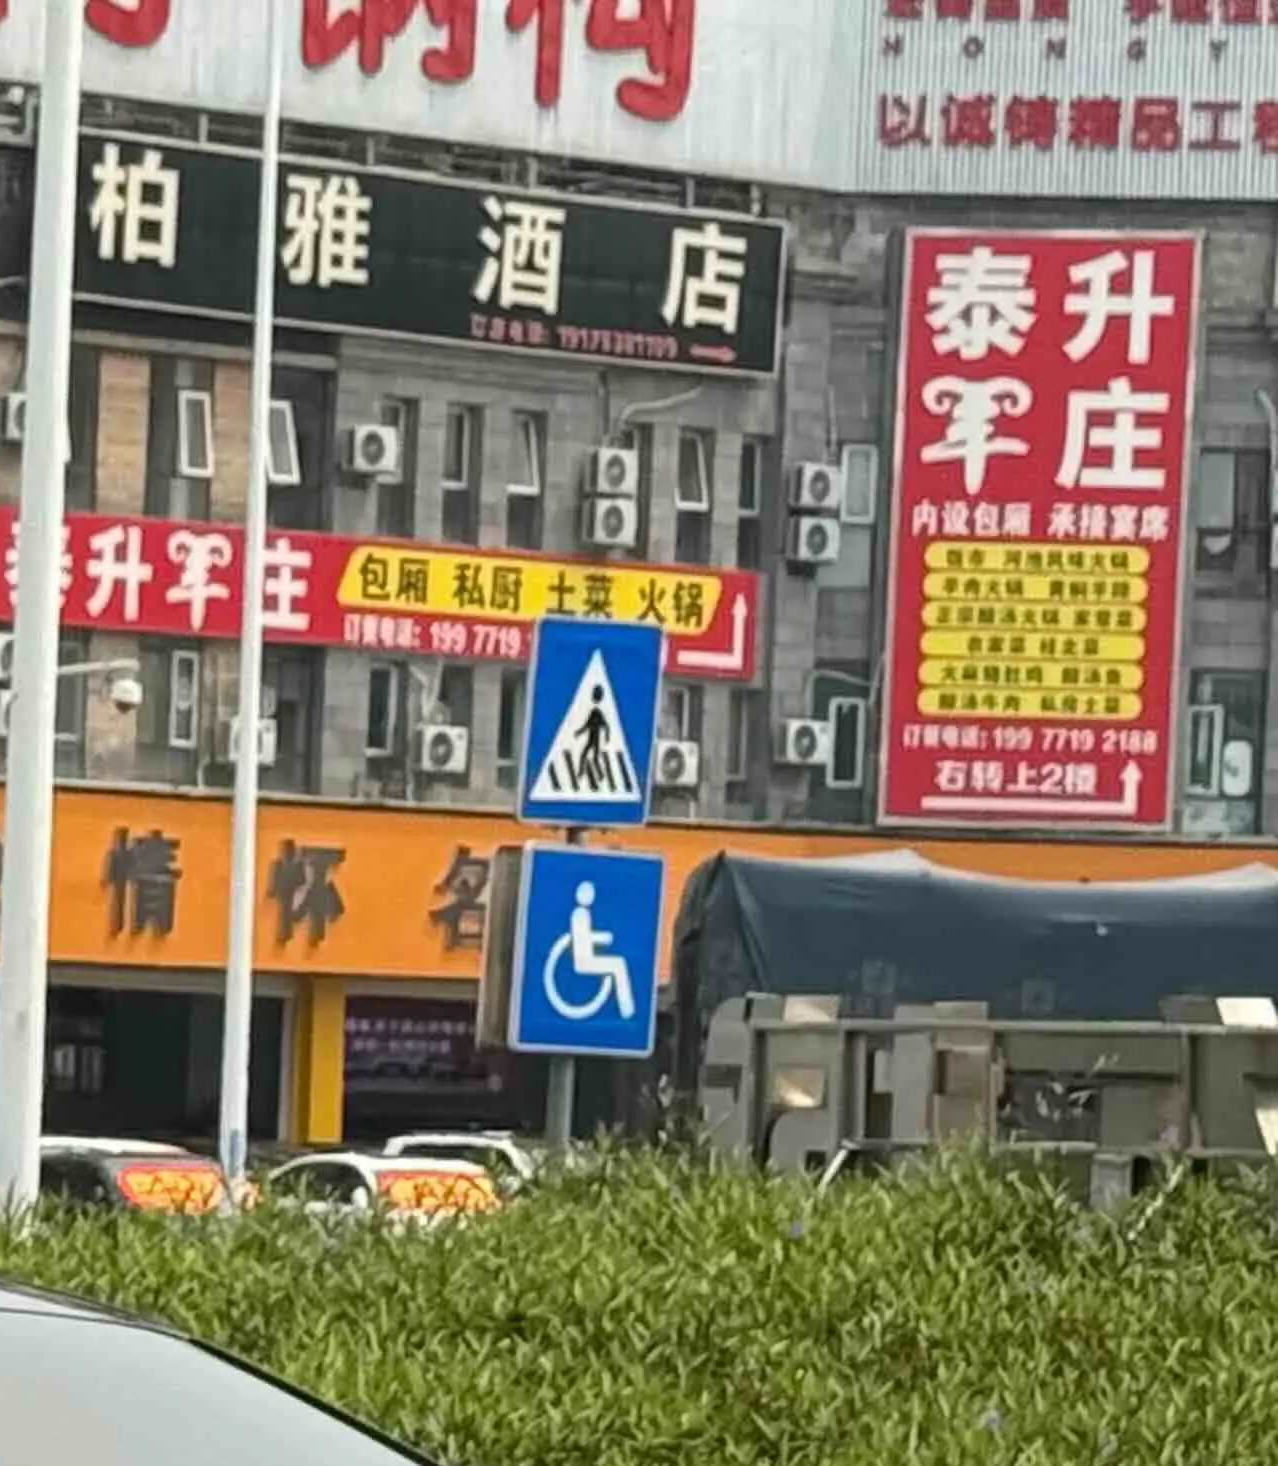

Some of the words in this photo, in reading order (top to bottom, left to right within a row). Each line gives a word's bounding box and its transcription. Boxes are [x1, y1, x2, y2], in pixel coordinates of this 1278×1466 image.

[89, 143, 748, 334] 柏雅酒店
[359, 552, 429, 602] 包厢
[453, 562, 523, 613] 私厨
[546, 572, 615, 619] 土菜
[638, 577, 706, 629] 火锅
